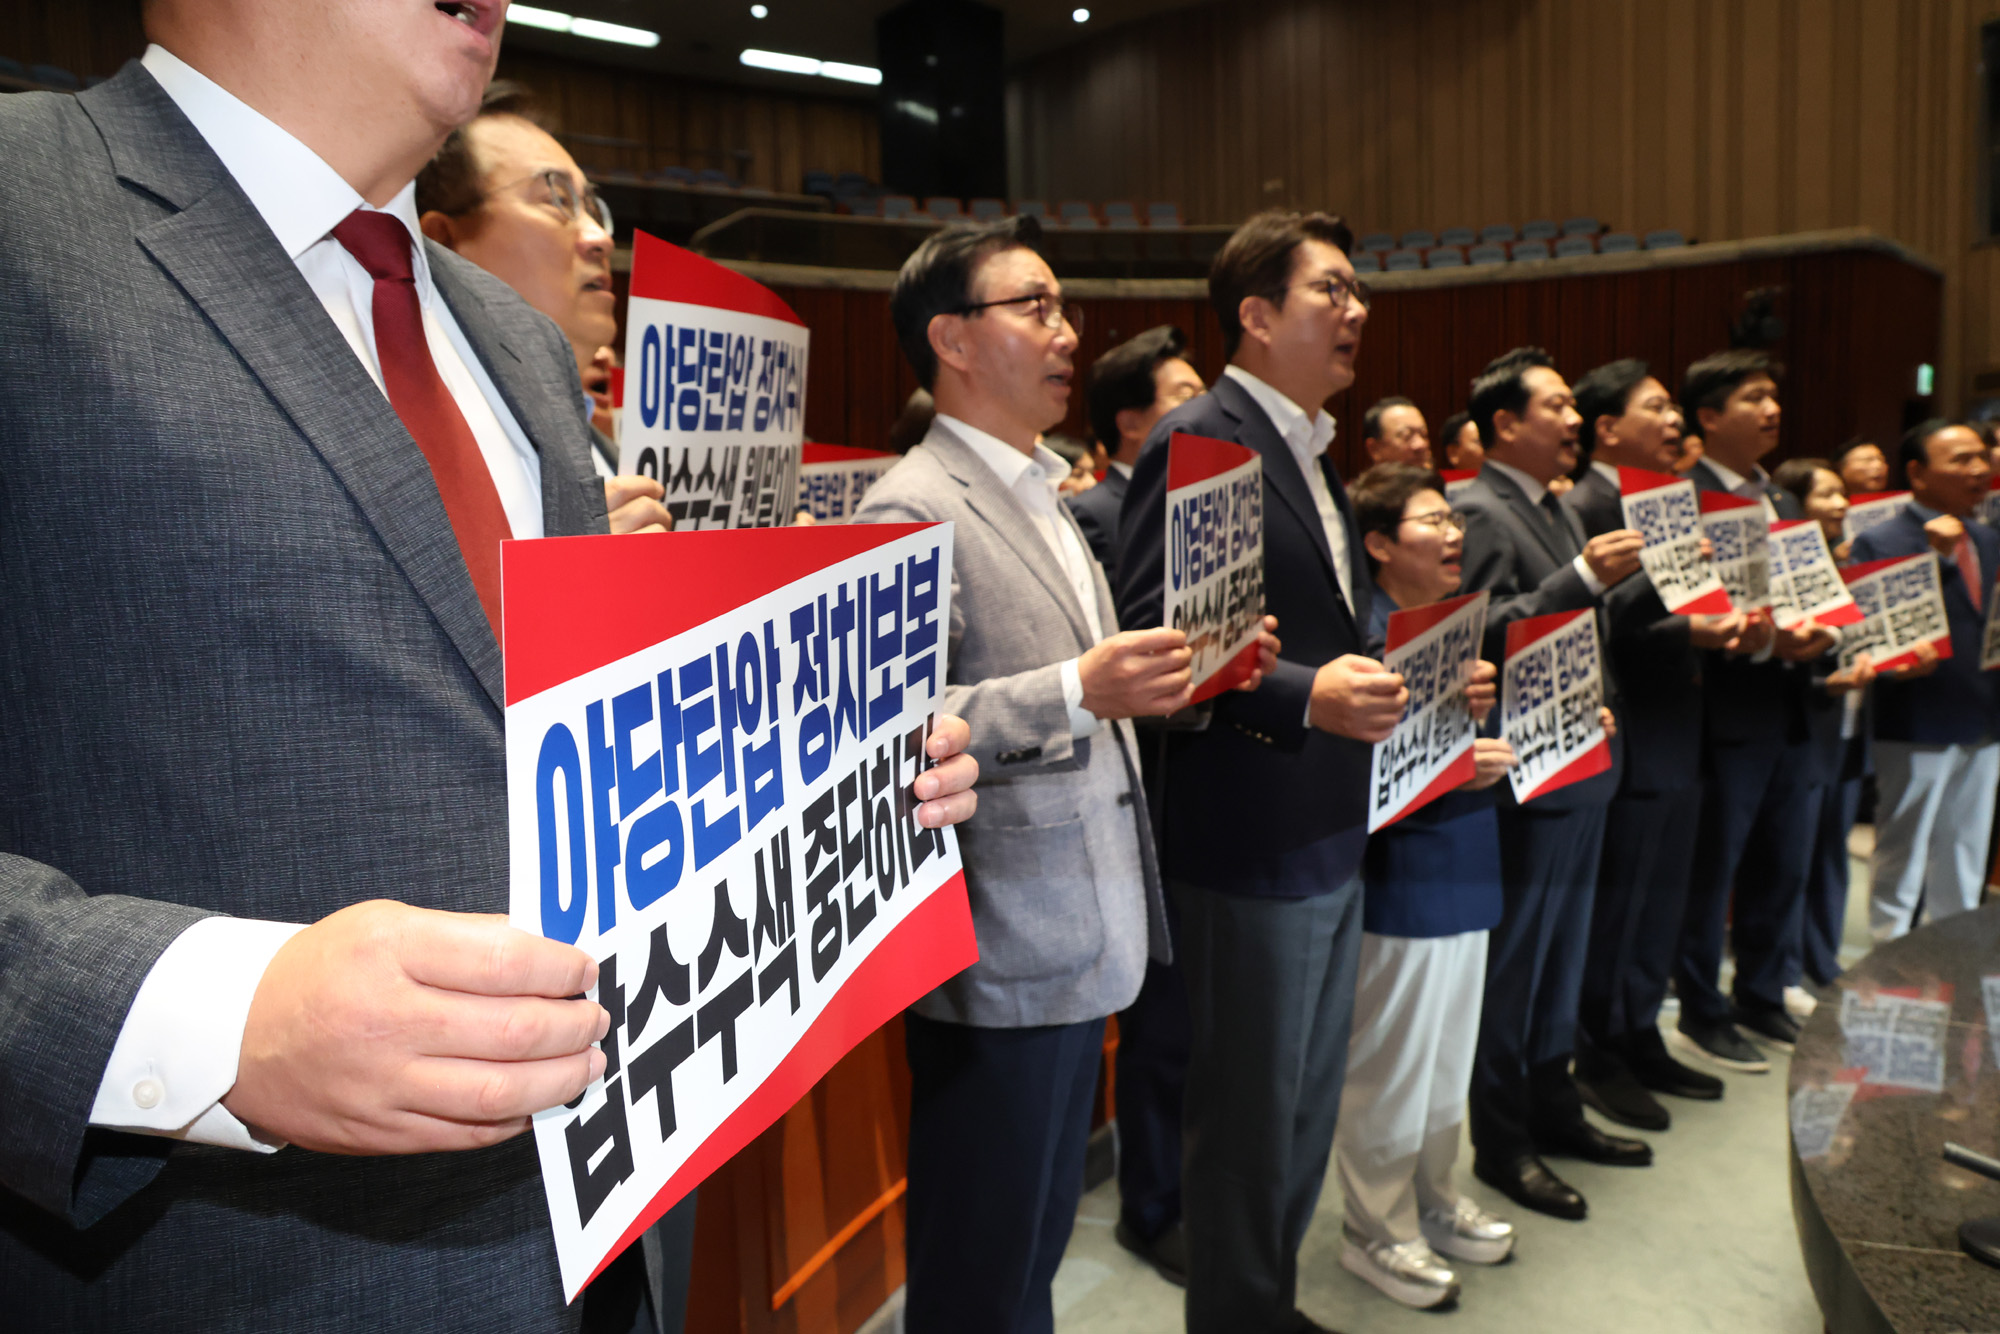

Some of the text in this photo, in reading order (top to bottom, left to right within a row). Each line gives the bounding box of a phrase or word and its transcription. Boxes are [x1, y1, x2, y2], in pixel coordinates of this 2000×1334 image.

[640, 323, 753, 432] 야당탄압
[1172, 483, 1229, 593] 야당탄압
[536, 546, 941, 944] 야당탄압 정치보복
